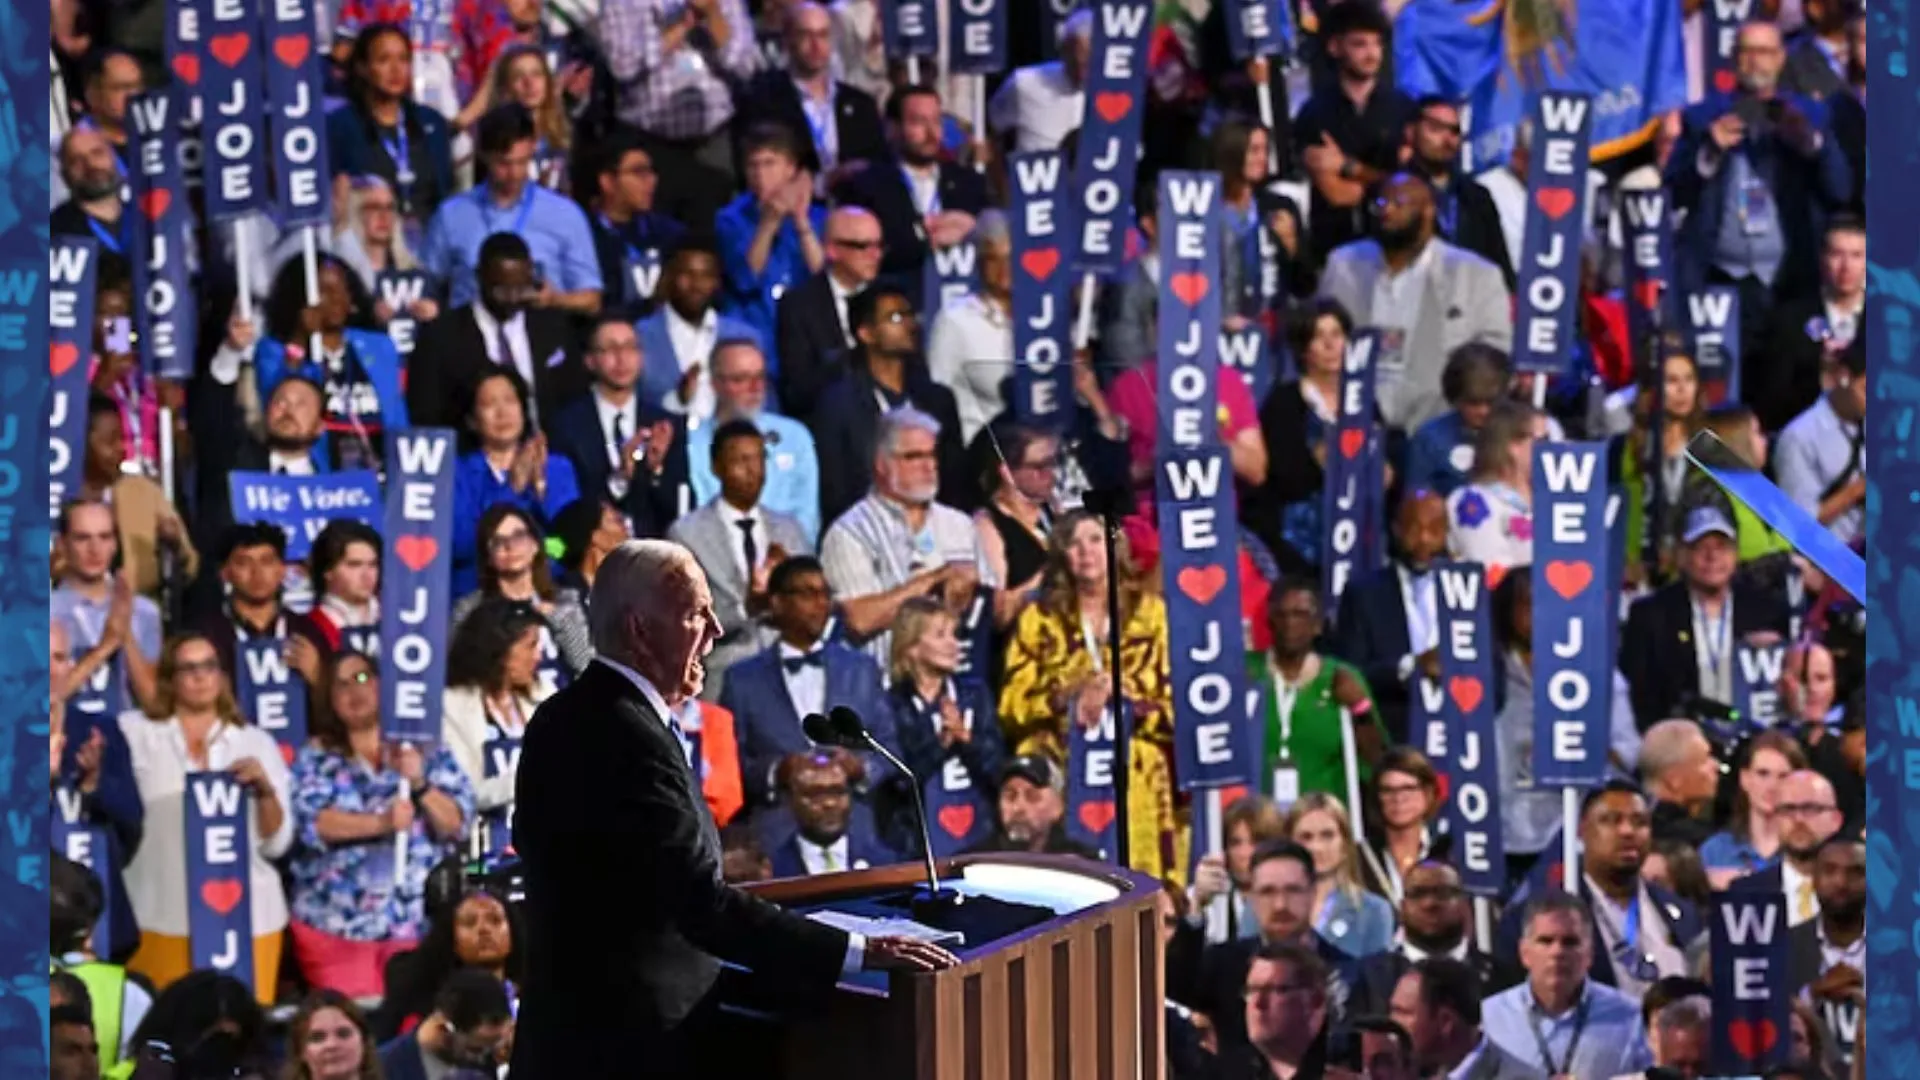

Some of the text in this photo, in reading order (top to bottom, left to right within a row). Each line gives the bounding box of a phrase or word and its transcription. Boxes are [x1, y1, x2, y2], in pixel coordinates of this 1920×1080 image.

[1102, 4, 1147, 79] WE
[215, 79, 253, 200] JOE
[283, 80, 319, 206] JOE
[1541, 95, 1587, 175] WE
[131, 96, 176, 357] WE JOE
[1083, 137, 1120, 254] JOE
[1626, 195, 1664, 267] WE
[50, 246, 90, 328] WE
[381, 277, 425, 353] WE
[1016, 156, 1061, 416] WE JOE
[1168, 179, 1215, 445] WE JOE
[1528, 233, 1565, 354] JOE
[1689, 292, 1733, 367] WE
[397, 436, 448, 521] WE
[1166, 456, 1222, 551] WE
[1541, 451, 1596, 543] WE
[392, 587, 433, 719] JOE
[1440, 568, 1480, 661] WE
[245, 647, 291, 730] WE
[1187, 620, 1233, 764] JOE
[1548, 616, 1591, 761] JOE
[1738, 647, 1785, 728] WE
[193, 779, 241, 864] WE
[1457, 731, 1490, 871] JOE
[1720, 902, 1779, 1000] WE
